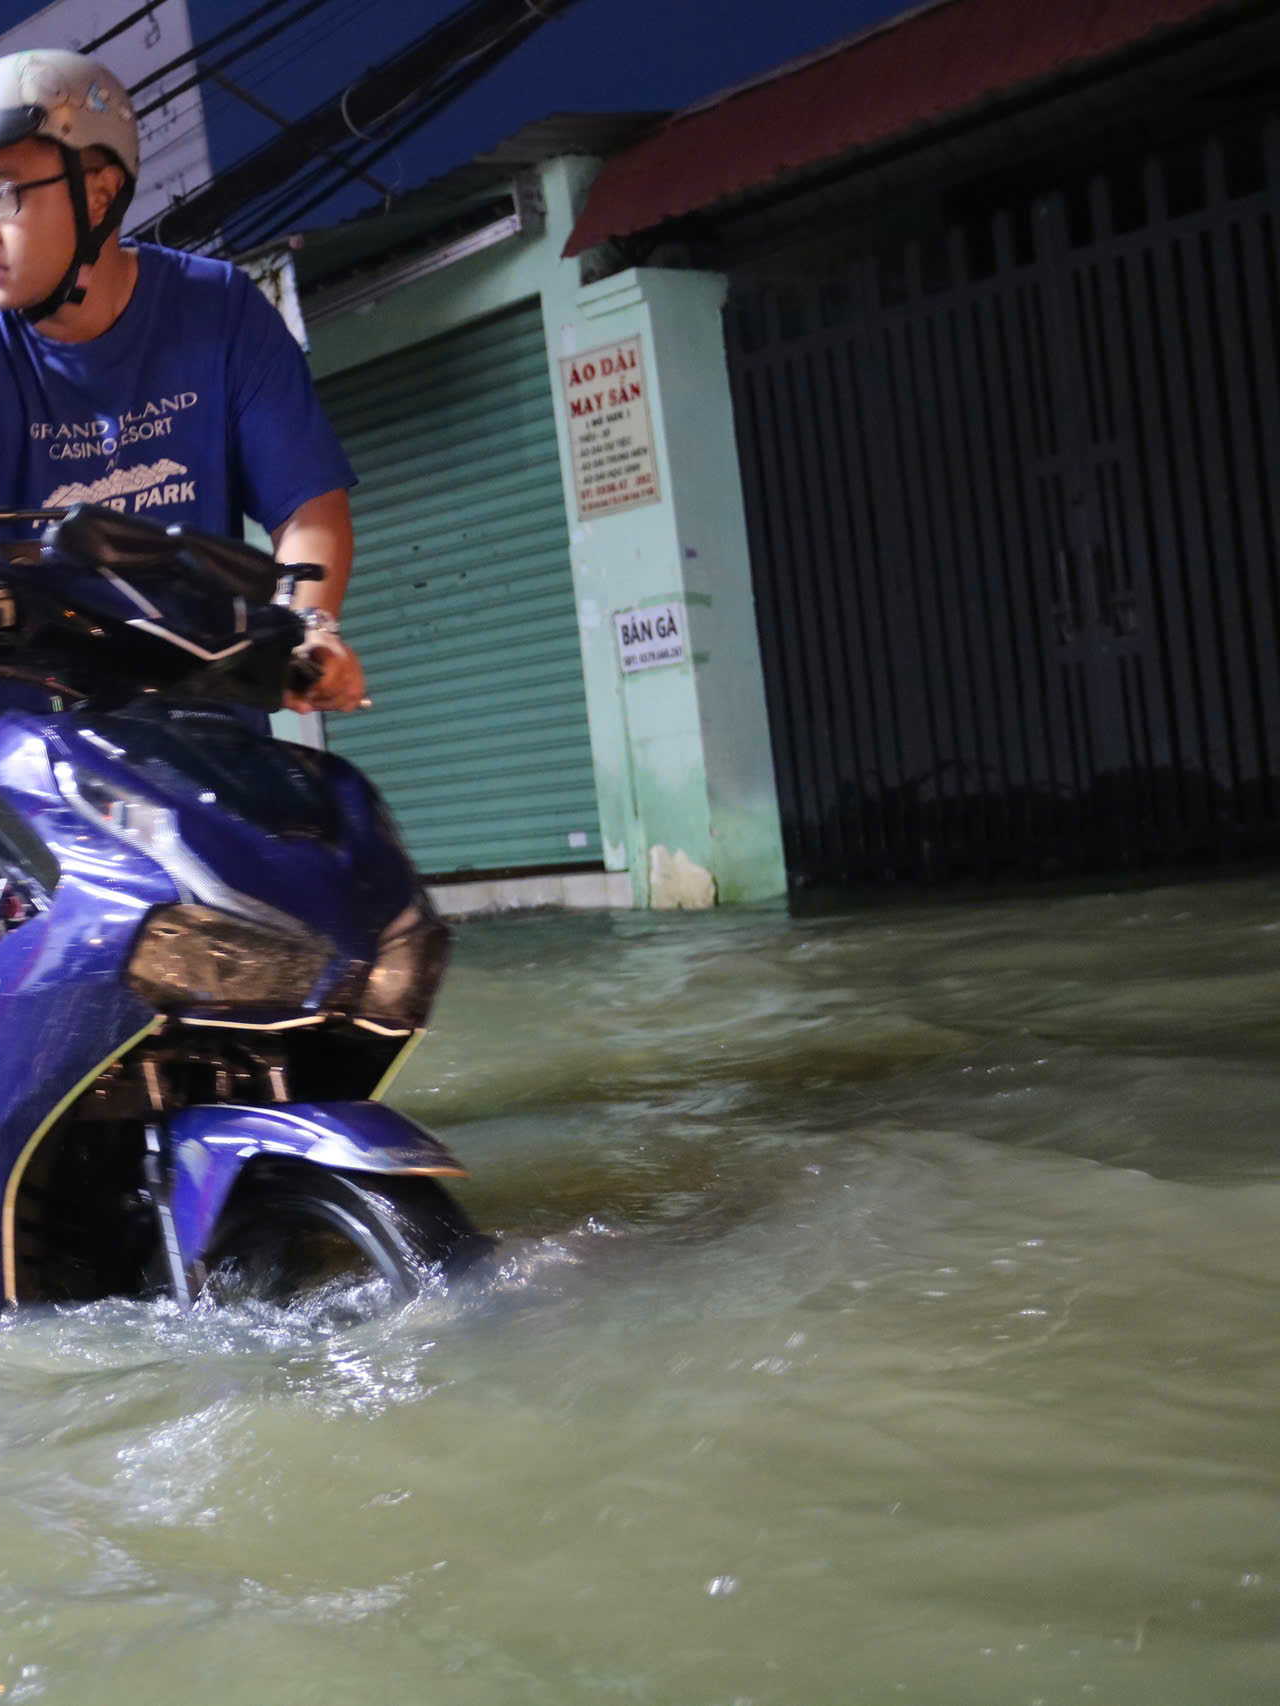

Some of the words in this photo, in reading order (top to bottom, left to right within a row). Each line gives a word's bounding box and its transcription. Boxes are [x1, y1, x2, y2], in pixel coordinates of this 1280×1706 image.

[569, 361, 596, 387] ÁO
[599, 348, 636, 376] DÀI
[30, 420, 109, 440] GRAND
[119, 392, 198, 430] ILAND
[569, 392, 603, 419] MAY
[48, 438, 117, 460] CASINO
[134, 480, 196, 513] PARK
[621, 615, 653, 645] BÁN
[656, 608, 678, 638] GÀ
